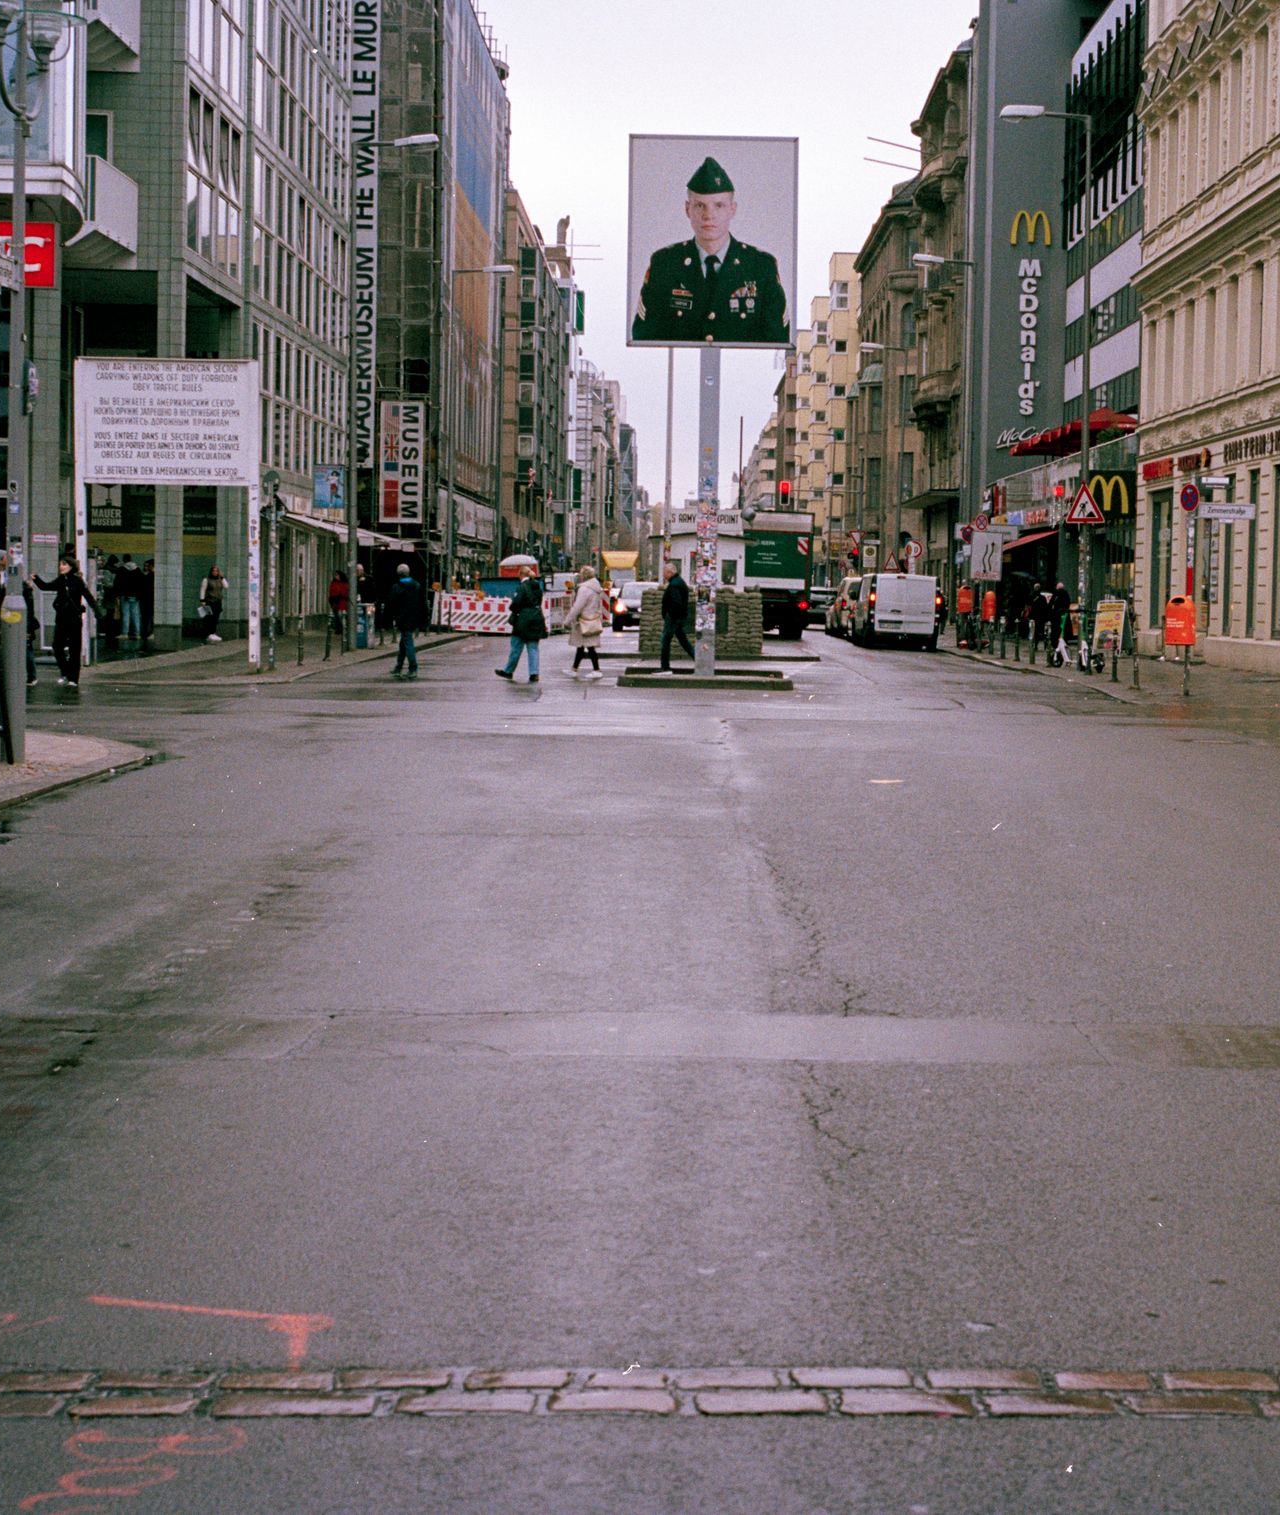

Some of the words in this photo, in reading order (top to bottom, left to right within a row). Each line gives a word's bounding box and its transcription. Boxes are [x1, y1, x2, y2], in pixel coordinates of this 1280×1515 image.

[353, 0, 378, 51] MUR
[353, 66, 376, 96] LE
[353, 110, 375, 175] WALL
[356, 187, 374, 230] THE
[1018, 259, 1042, 416] McDonald's
[355, 247, 374, 464] MAUERMUSEUM
[96, 363, 110, 371] YOU
[113, 363, 124, 371] ARE
[129, 363, 159, 371] ENTERING
[162, 363, 173, 371] THE
[176, 364, 210, 372] AMERICAN
[214, 364, 239, 373] SECTOR
[96, 372, 130, 381] CARRYING
[132, 373, 164, 381] WEAPONS
[166, 373, 178, 381] OFF
[182, 374, 198, 382] DUTY
[201, 374, 238, 382] FORBIDDEN
[133, 383, 151, 391] OBEY
[153, 383, 178, 392] TRAFFIC
[182, 384, 202, 392] RULES
[211, 399, 235, 407] СЕКТОР
[222, 409, 240, 417] ВРЕМЯ
[94, 432, 111, 440] VOUS
[114, 432, 138, 440] ENTREZ
[142, 432, 159, 440] DANS
[171, 433, 199, 441] SECTEUR
[203, 434, 239, 442] AMERICAIN
[94, 441, 116, 449] DEFENSE
[117, 441, 124, 449] DE
[125, 441, 145, 449] PORTER
[157, 442, 174, 450] ARMES
[176, 442, 183, 450] EN
[185, 442, 207, 450] DEHORS
[208, 443, 217, 451] DU
[218, 443, 240, 451] SERVICE
[101, 450, 133, 459] OBEISSEZ
[136, 451, 149, 459] AUX
[153, 451, 175, 459] REGLES
[178, 452, 186, 460] DE
[189, 452, 231, 460] CIRCULATION
[401, 405, 419, 518] MUSEUM
[94, 466, 104, 475] SIE
[107, 466, 138, 475] BETRETEN
[141, 466, 153, 475] DEN
[155, 467, 211, 476] AMERIKANISCHEN
[214, 467, 238, 476] SEKTOR
[91, 508, 122, 518] MAUER
[679, 513, 696, 523] ARMY
[91, 518, 121, 526] MUSEUM
